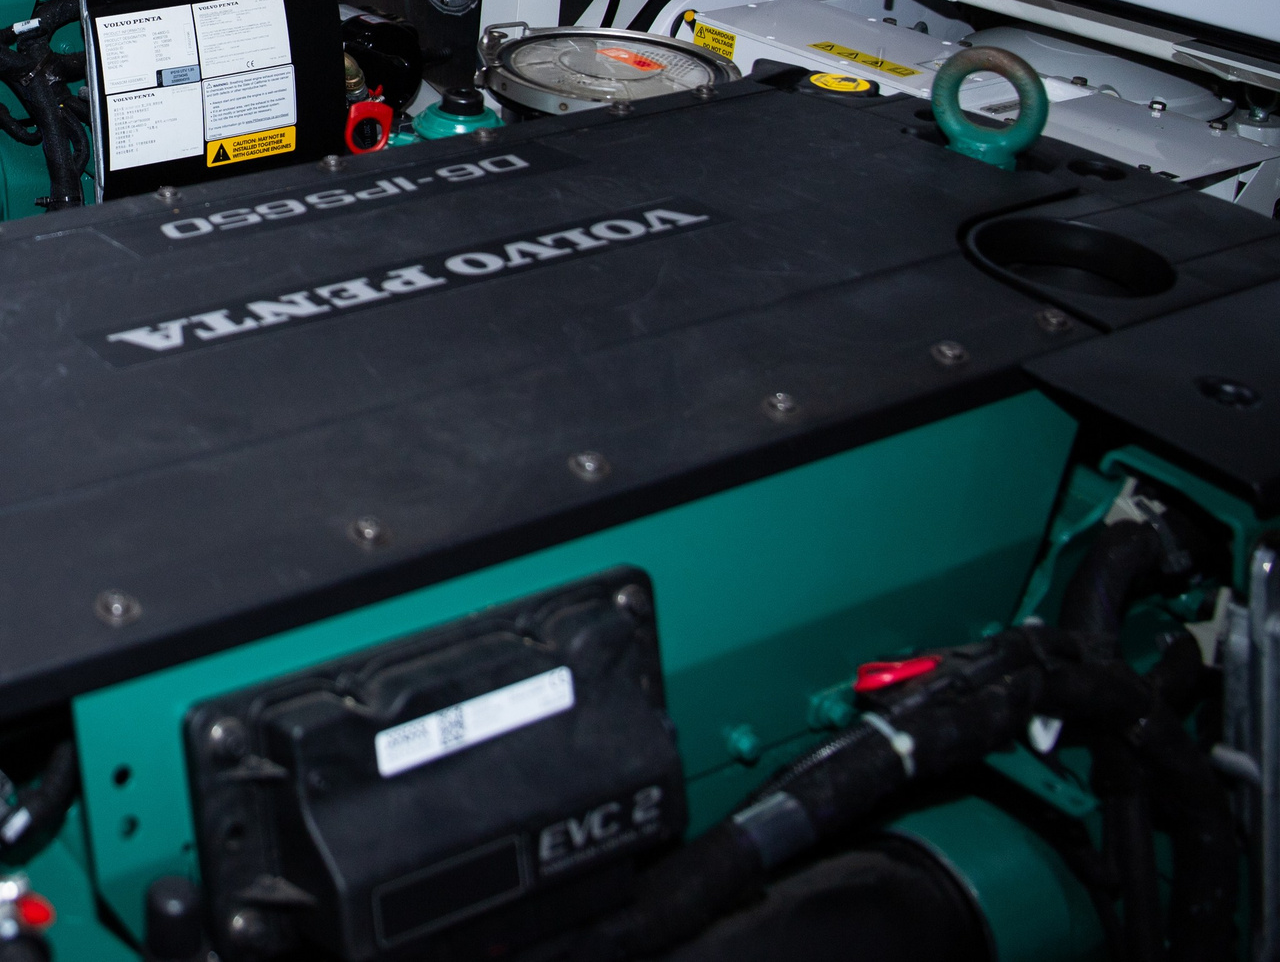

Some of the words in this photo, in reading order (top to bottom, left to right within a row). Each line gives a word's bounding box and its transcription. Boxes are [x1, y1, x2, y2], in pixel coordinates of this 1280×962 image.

[104, 20, 131, 29] VOLVO
[133, 15, 162, 24] PENTA
[705, 27, 734, 41] HAZARDOUS
[712, 37, 733, 48] VOLTAGE
[233, 139, 256, 147] CAUTION:
[233, 144, 257, 153] INSTALLED
[259, 139, 282, 148] TOGETHER
[246, 147, 270, 156] GASOLINE
[271, 143, 291, 151] ENGINES
[160, 153, 530, 241] D6-IPS650
[445, 208, 711, 277] VOLVO
[107, 265, 447, 352] PENTA
[540, 801, 620, 860] EVC
[632, 785, 663, 823] 2
